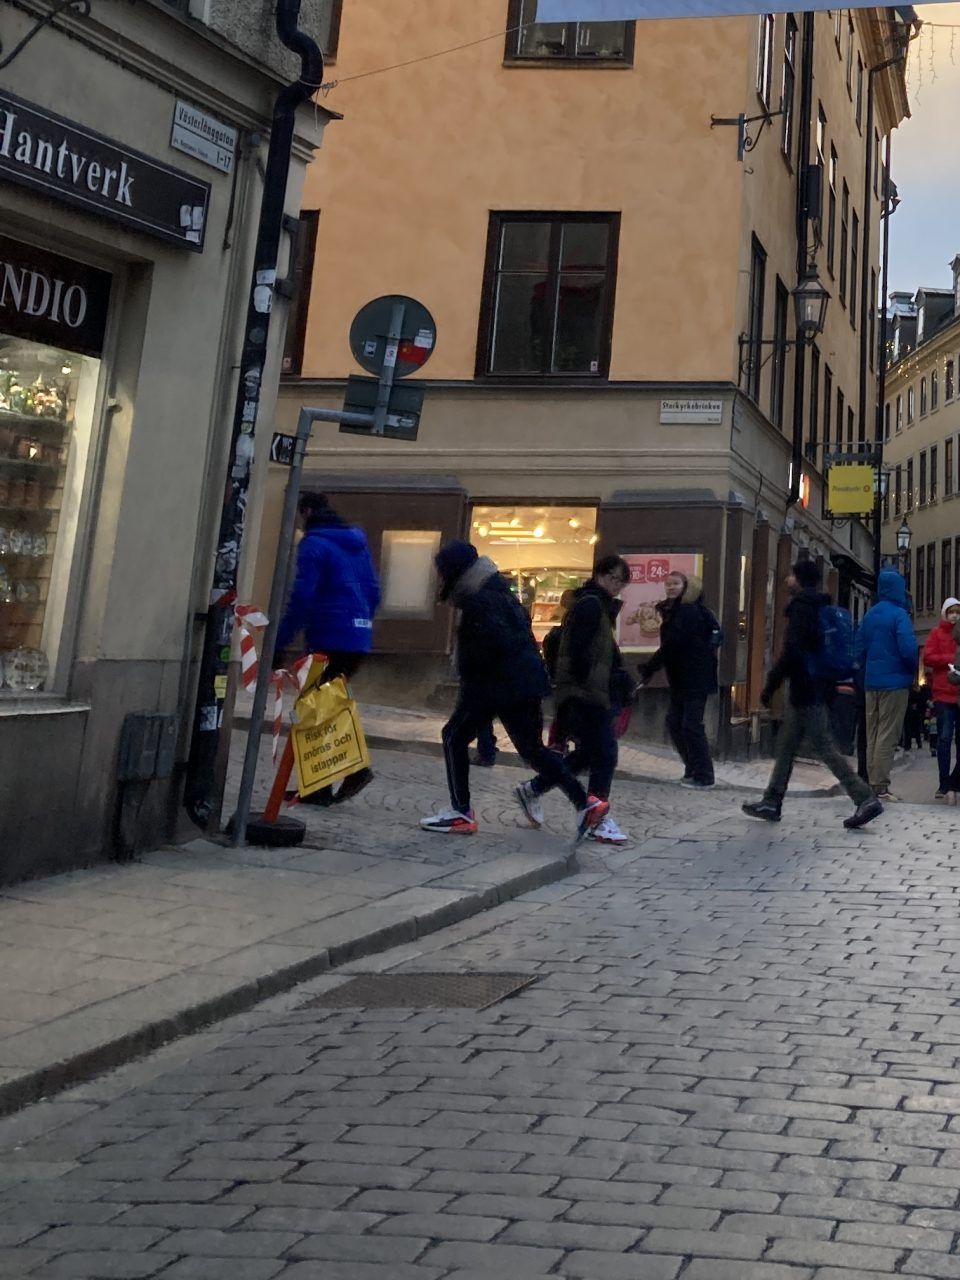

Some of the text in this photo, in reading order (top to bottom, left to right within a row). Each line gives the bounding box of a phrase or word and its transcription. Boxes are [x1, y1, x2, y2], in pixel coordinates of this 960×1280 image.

[179, 107, 234, 146] Västerlånggatan
[0, 109, 134, 207] Hantverk
[216, 151, 231, 169] 1-17
[282, 437, 293, 450] WC
[305, 723, 337, 745] Risk för
[303, 732, 352, 762] snöras och
[310, 751, 348, 775] istappar
